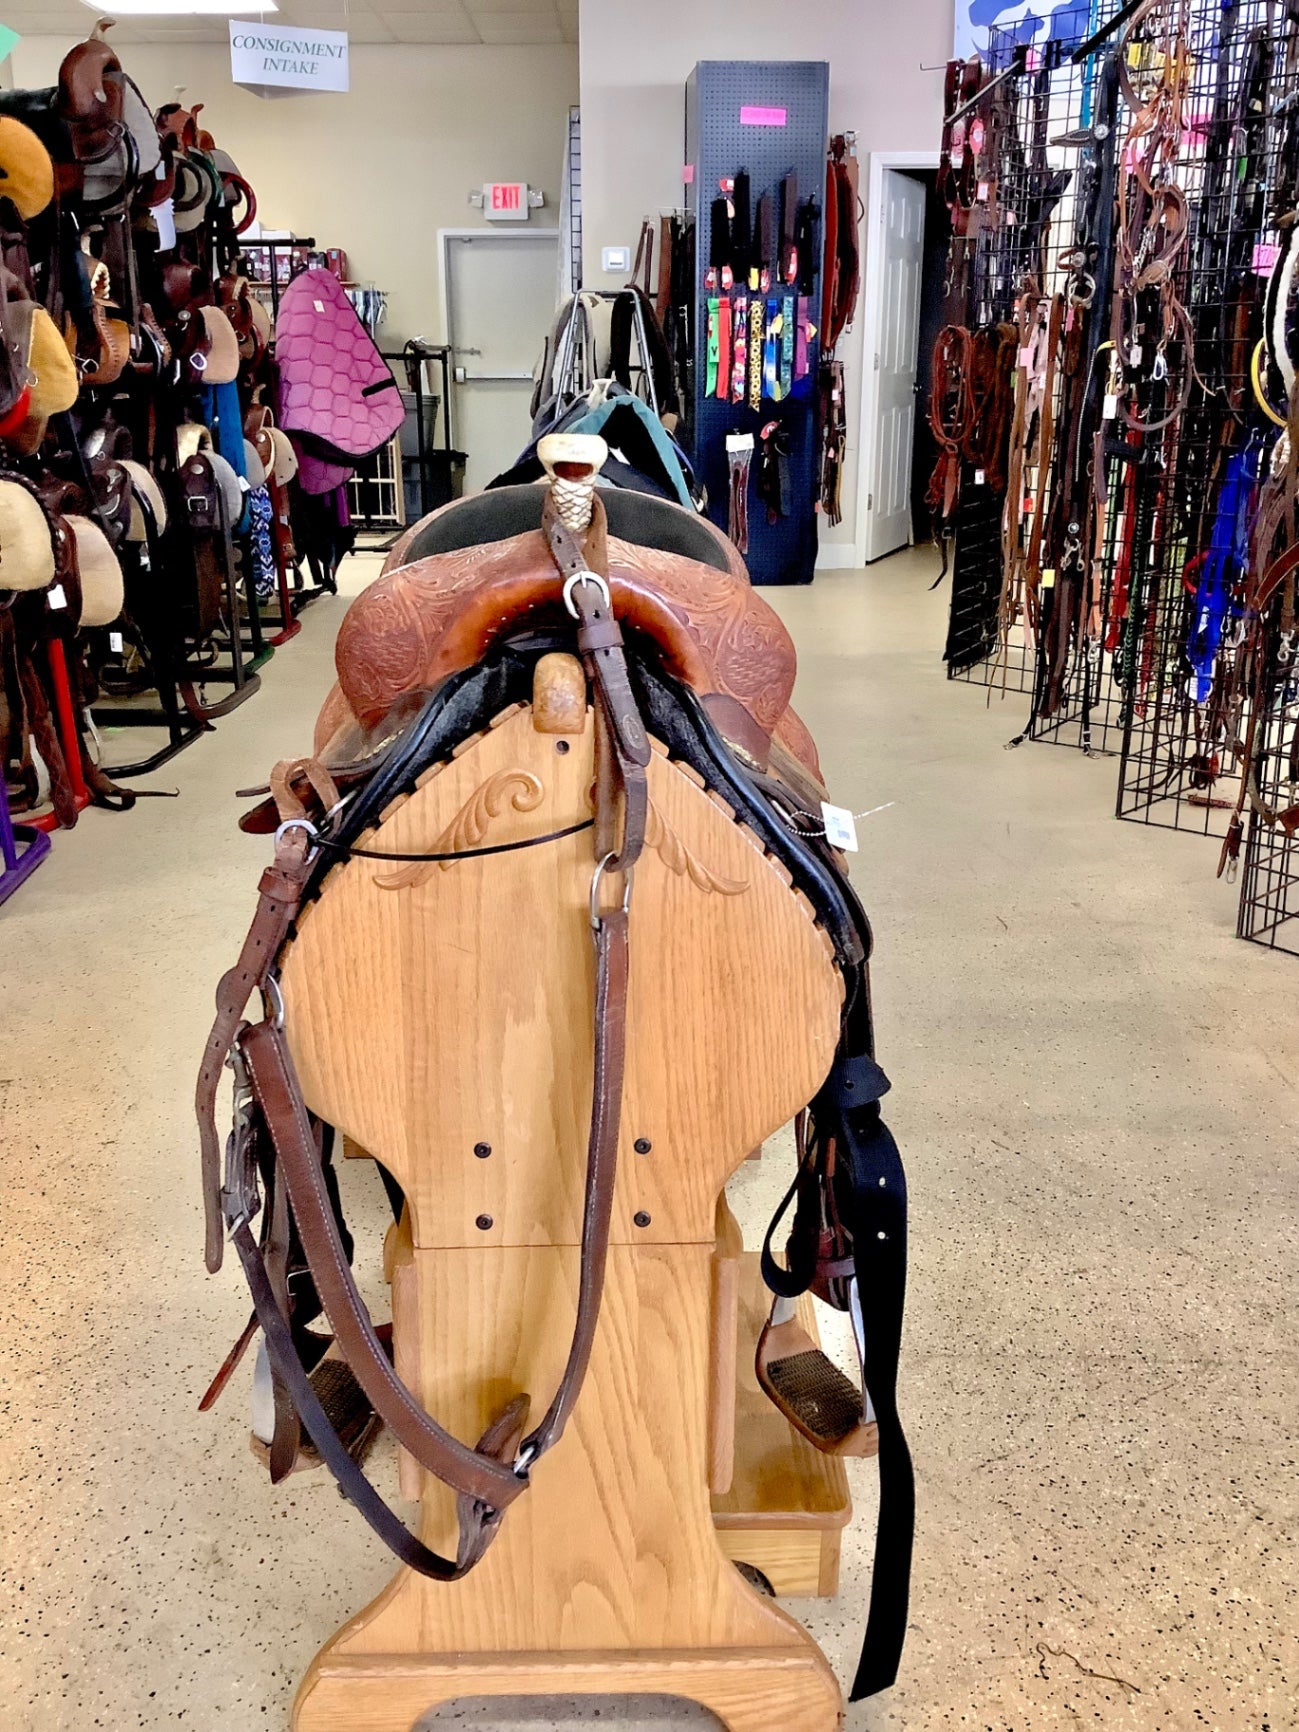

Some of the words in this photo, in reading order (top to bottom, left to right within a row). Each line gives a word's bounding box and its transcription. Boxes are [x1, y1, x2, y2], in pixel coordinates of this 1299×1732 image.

[232, 35, 346, 58] CONSIGNMENT
[263, 57, 319, 75] INTAKE
[492, 186, 520, 209] EXIT
